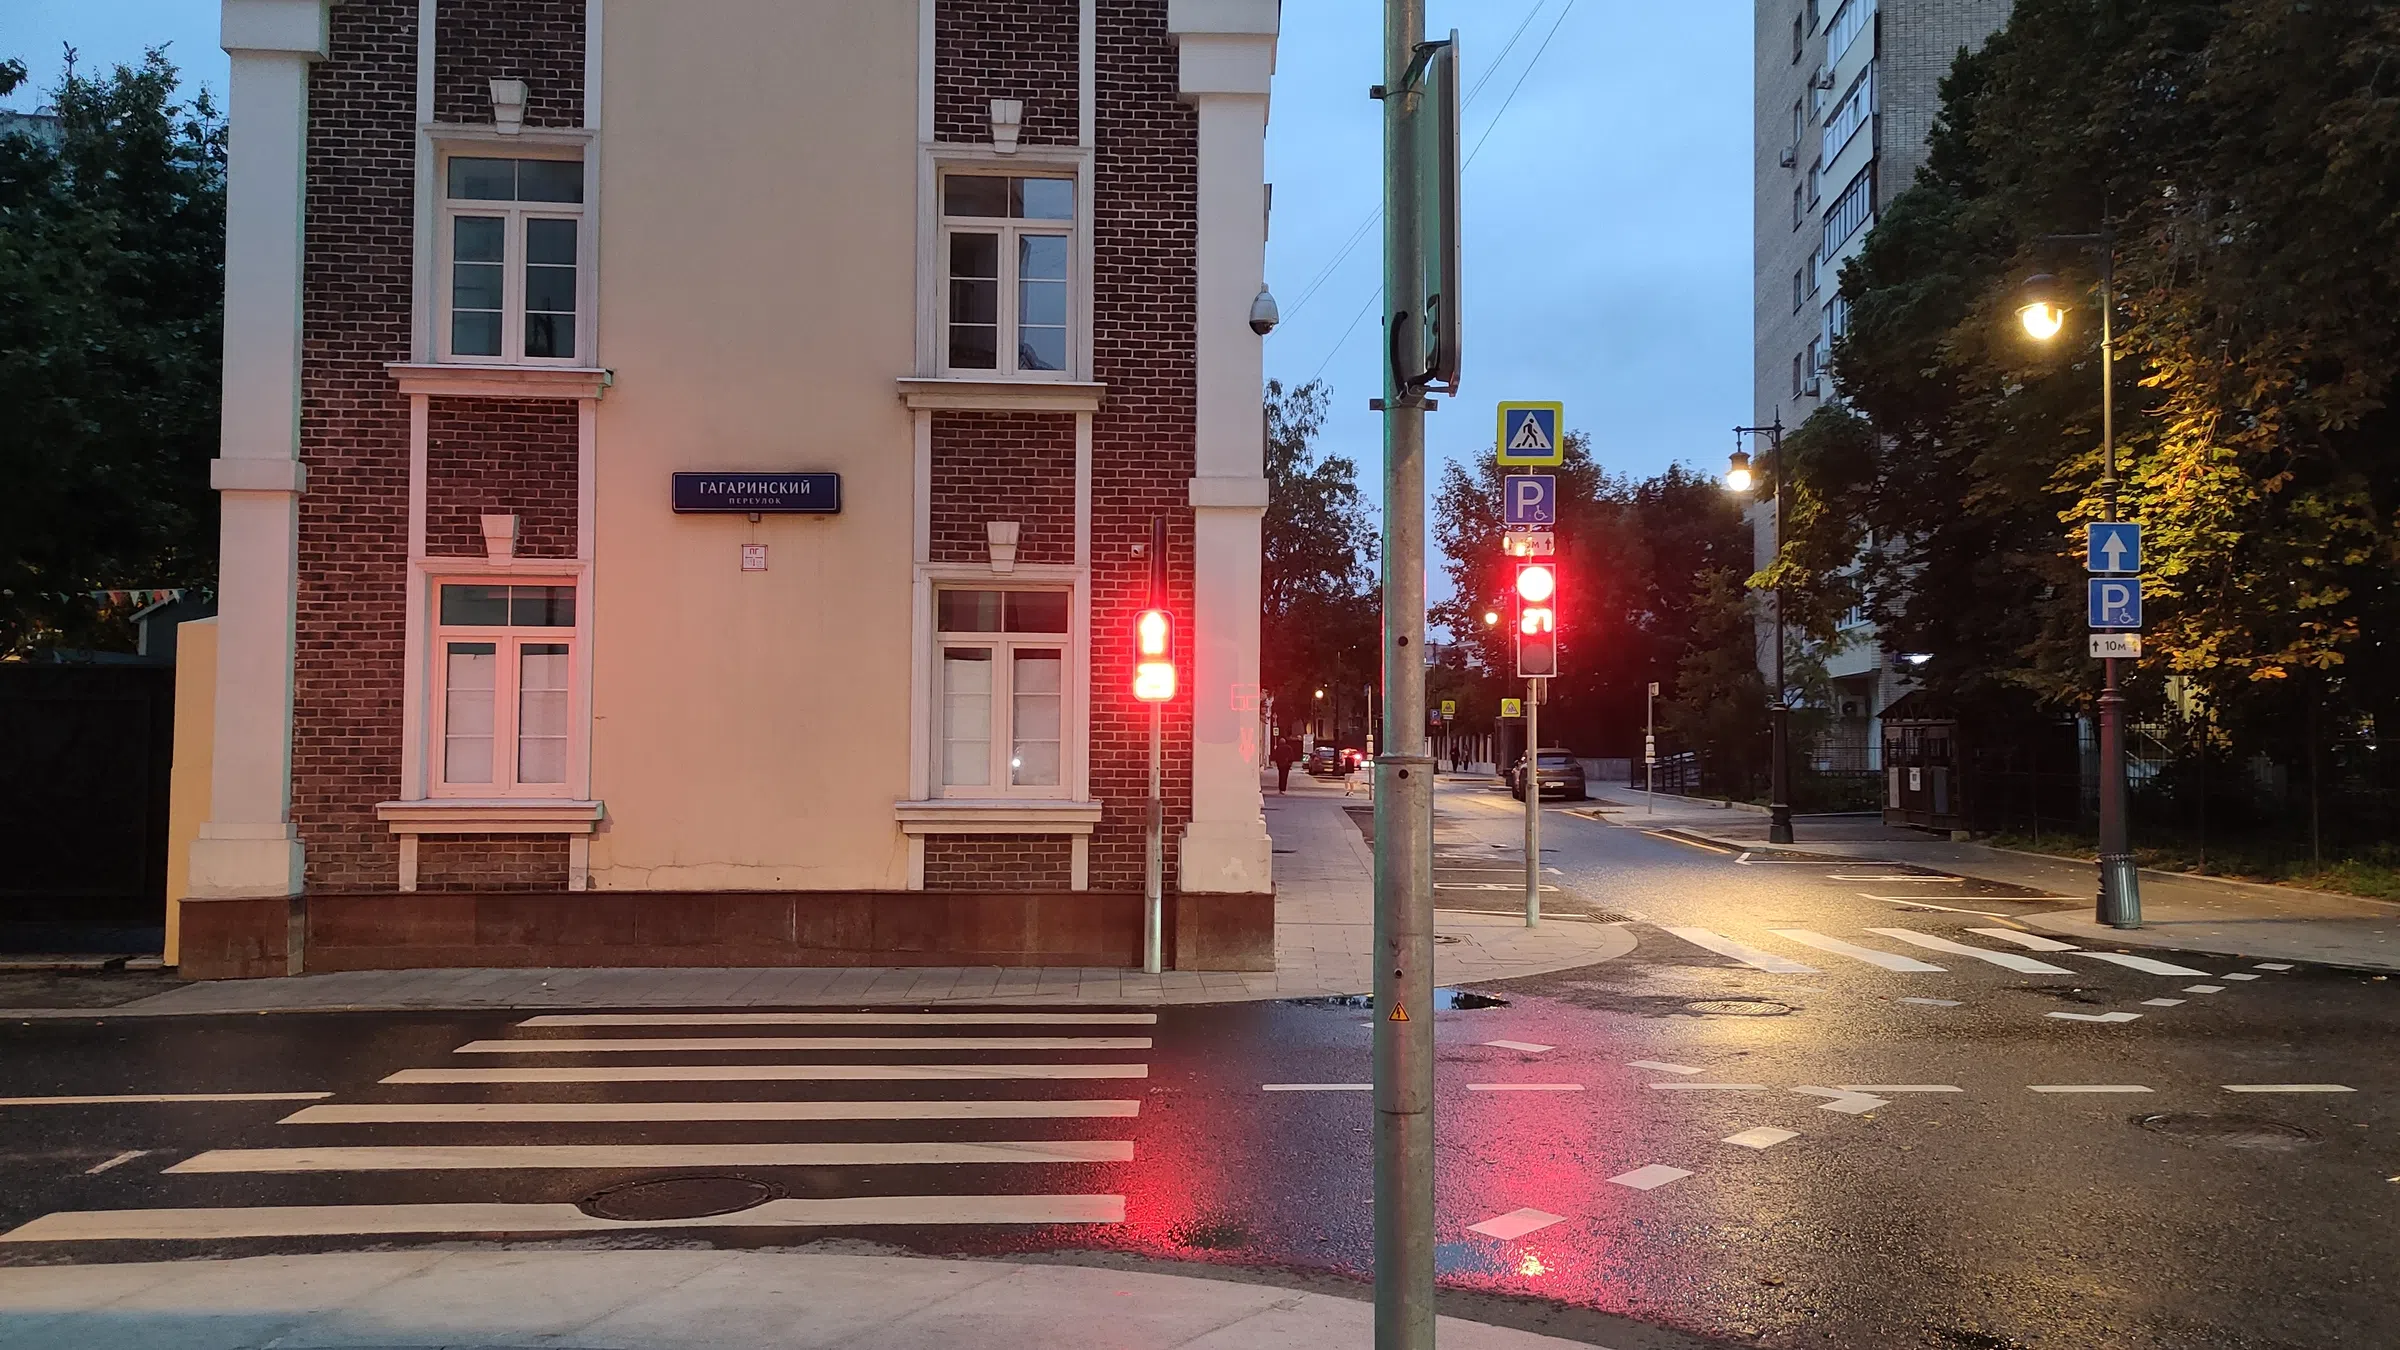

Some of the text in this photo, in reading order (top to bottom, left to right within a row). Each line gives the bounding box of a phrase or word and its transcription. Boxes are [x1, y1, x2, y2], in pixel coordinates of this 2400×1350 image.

[699, 479, 811, 494] ГАГАРИНСКИЙ
[1517, 481, 1544, 518] P
[728, 497, 782, 505] ПЕРЕУЛОК
[2101, 584, 2130, 621] P
